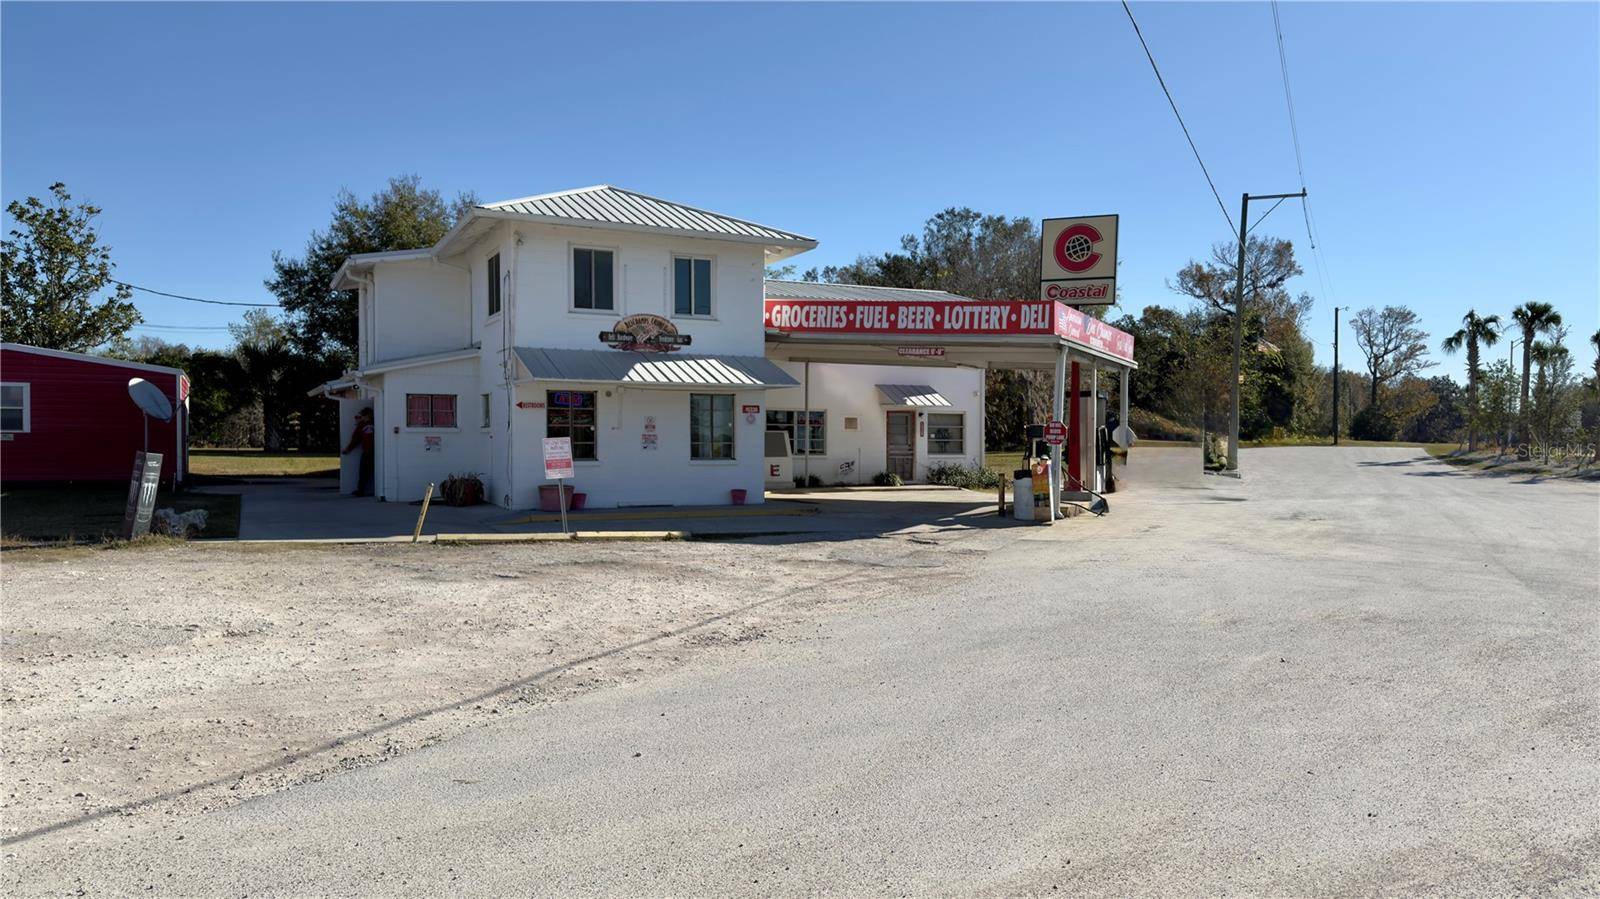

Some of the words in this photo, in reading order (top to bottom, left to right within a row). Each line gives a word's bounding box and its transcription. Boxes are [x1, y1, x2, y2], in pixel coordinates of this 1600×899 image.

[1046, 283, 1110, 300] Coastal
[771, 304, 847, 329] GROCERIES
[855, 305, 890, 329] FUEL
[897, 305, 934, 330] BEER
[943, 305, 1011, 330] LOTTERY
[1020, 304, 1050, 330] DELI
[898, 347, 929, 356] CLEARANCE
[770, 464, 780, 477] E
